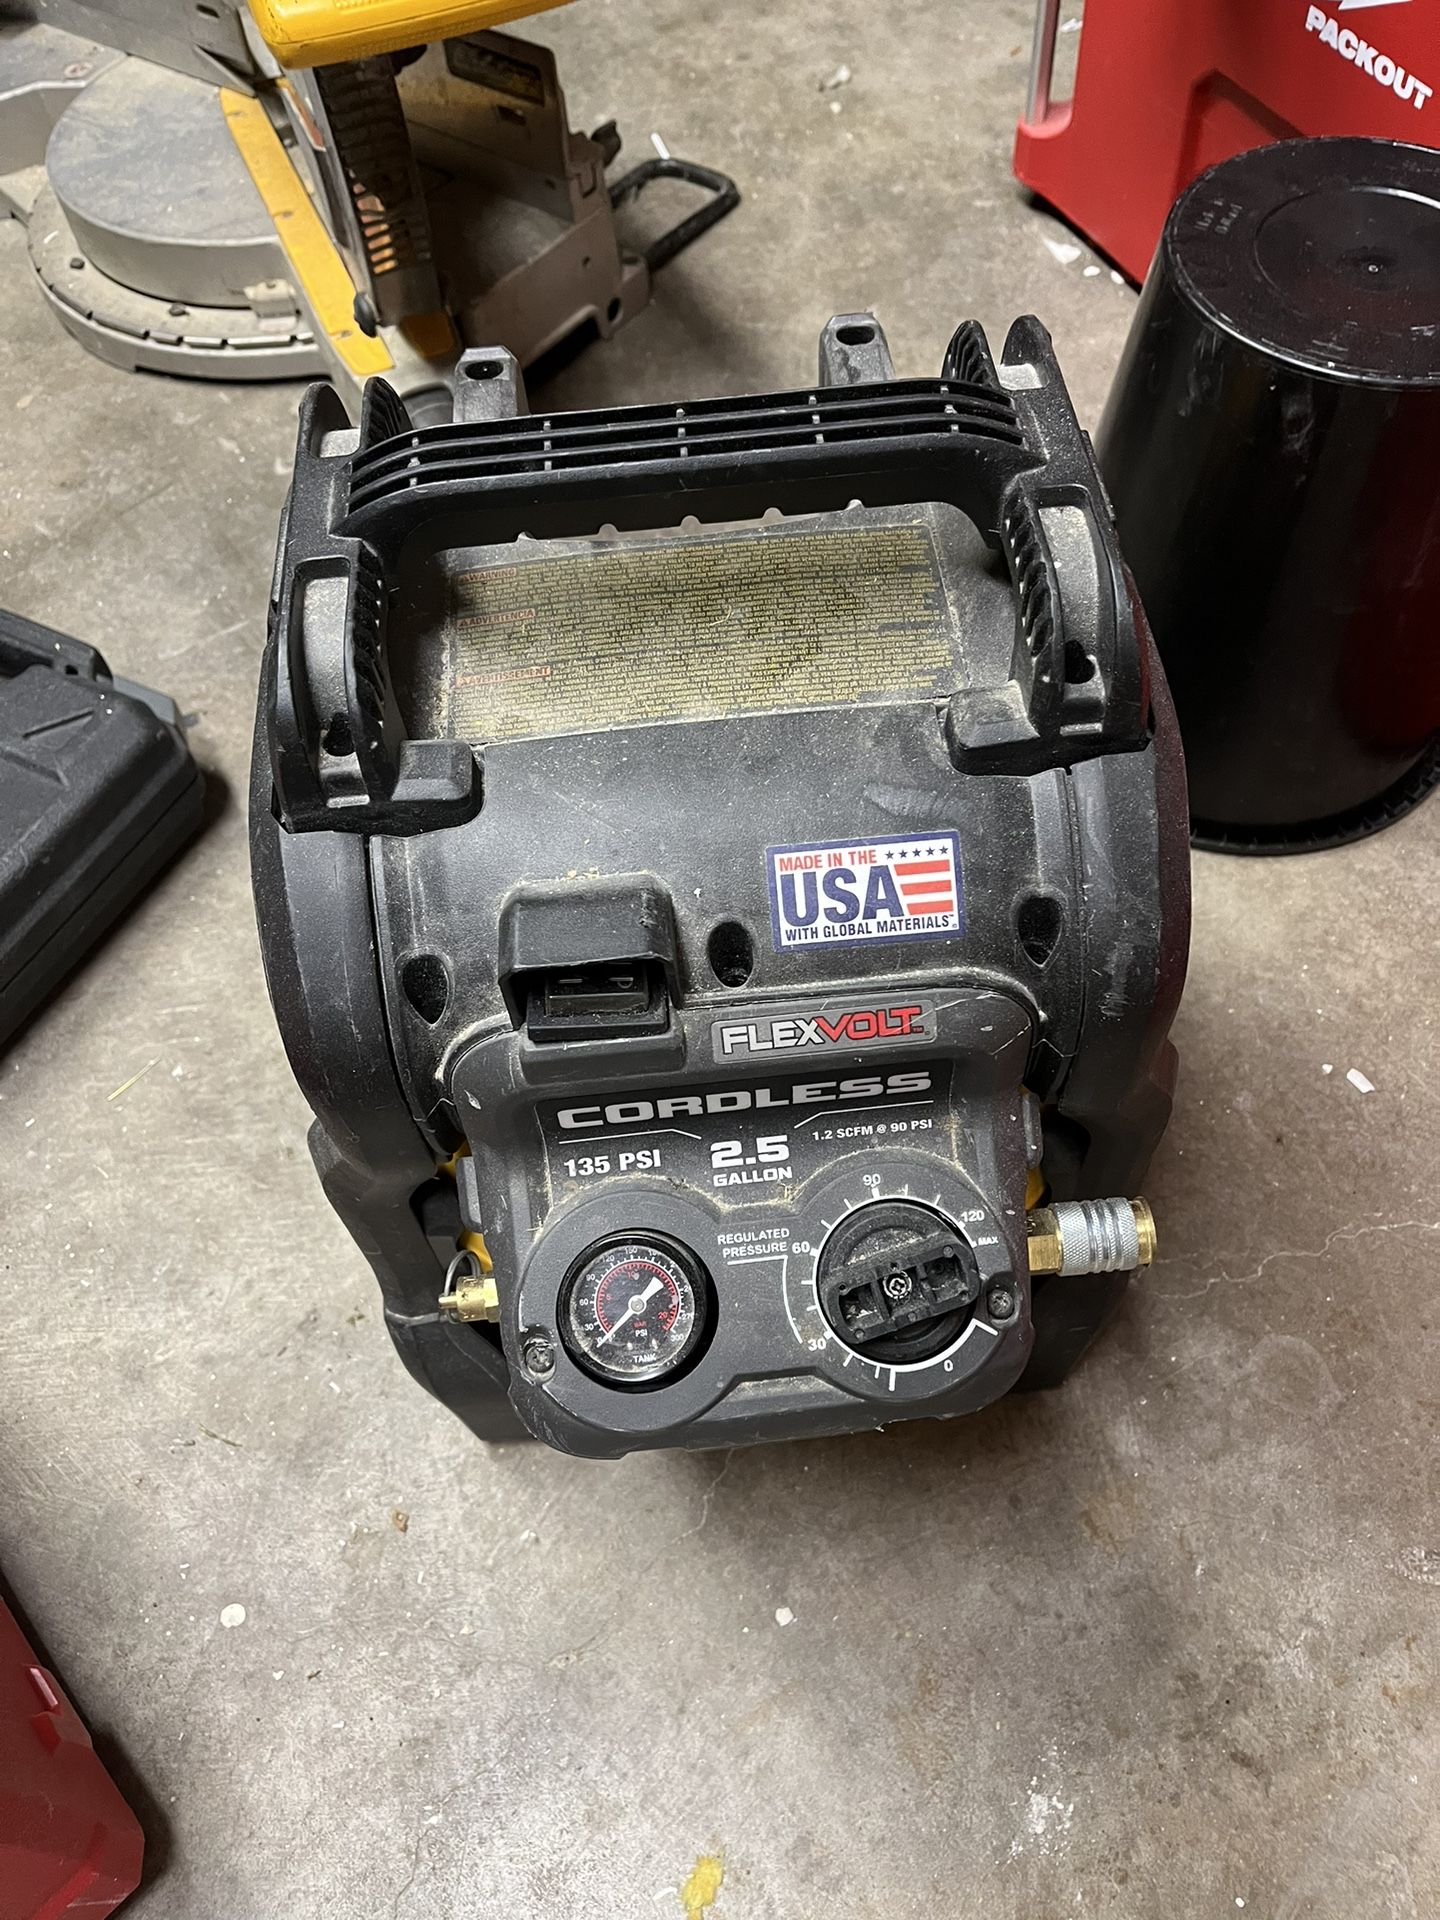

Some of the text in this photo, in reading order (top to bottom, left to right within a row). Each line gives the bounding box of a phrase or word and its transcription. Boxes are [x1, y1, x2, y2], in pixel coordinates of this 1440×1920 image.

[1305, 4, 1433, 110] PACKOUT
[469, 568, 514, 581] WARNING
[470, 609, 533, 625] ADVERTENCIA
[779, 849, 876, 872] MADE IN THE
[780, 865, 904, 927] USA
[785, 927, 819, 941] WITH
[823, 921, 872, 938] GLOBAL
[557, 1071, 932, 1129] CORDLESS
[812, 1119, 933, 1141] 1.2 SCFM @ 90 PSI
[710, 1135, 790, 1168] 2.5
[564, 1149, 661, 1177] 135 PSI
[713, 1166, 793, 1187] GALLON
[862, 1173, 881, 1187] 90
[961, 1210, 985, 1223] 120
[717, 1228, 790, 1245] REGULATED
[978, 1235, 999, 1246] MAX
[722, 1242, 788, 1258] PRESSURE
[792, 1241, 811, 1254] 60
[586, 1273, 596, 1282] 90
[584, 1322, 594, 1331] 30
[635, 1329, 648, 1337] PSI
[671, 1333, 685, 1342] 300
[808, 1338, 827, 1352] 30
[633, 1352, 656, 1363] TANK
[943, 1361, 953, 1373] 0
